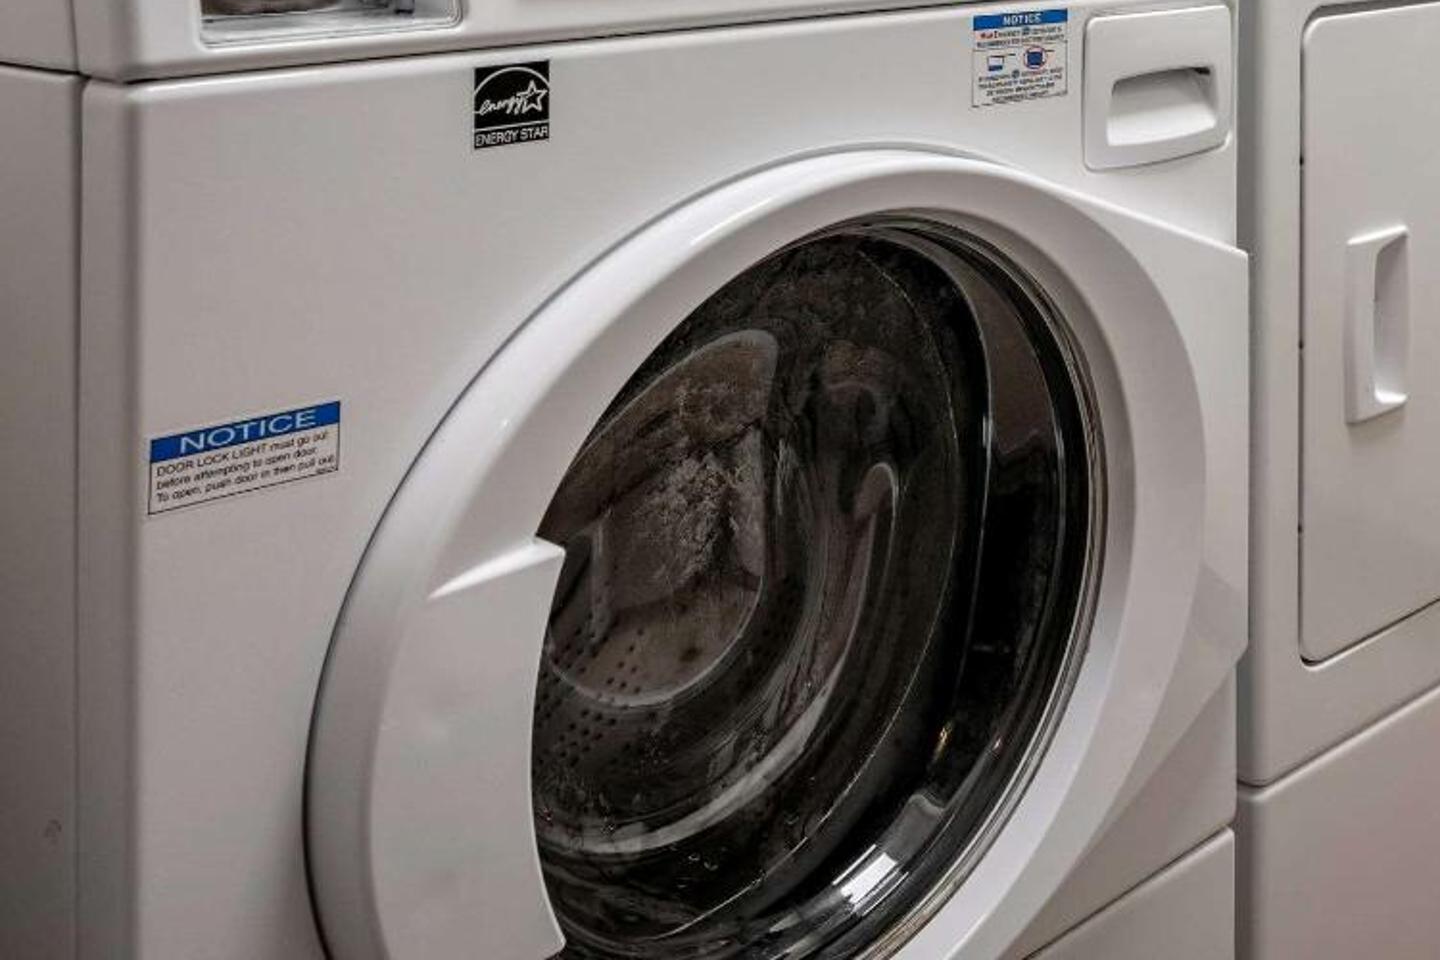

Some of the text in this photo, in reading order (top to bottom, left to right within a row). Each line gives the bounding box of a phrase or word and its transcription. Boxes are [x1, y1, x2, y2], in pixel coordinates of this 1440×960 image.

[1002, 13, 1042, 26] NOTICE
[475, 126, 548, 147] ENERGY STAR
[179, 409, 317, 454] NOTICE
[156, 430, 329, 478] DOOR LOCK LIGHT must go out
[156, 475, 191, 491] before
[194, 461, 250, 483] attempting
[252, 457, 263, 468] to
[265, 452, 291, 466] open
[156, 490, 170, 503] To
[204, 477, 232, 492] push
[235, 471, 258, 486] door
[260, 468, 271, 479] in
[273, 464, 296, 477] then
[297, 457, 316, 472] pull
